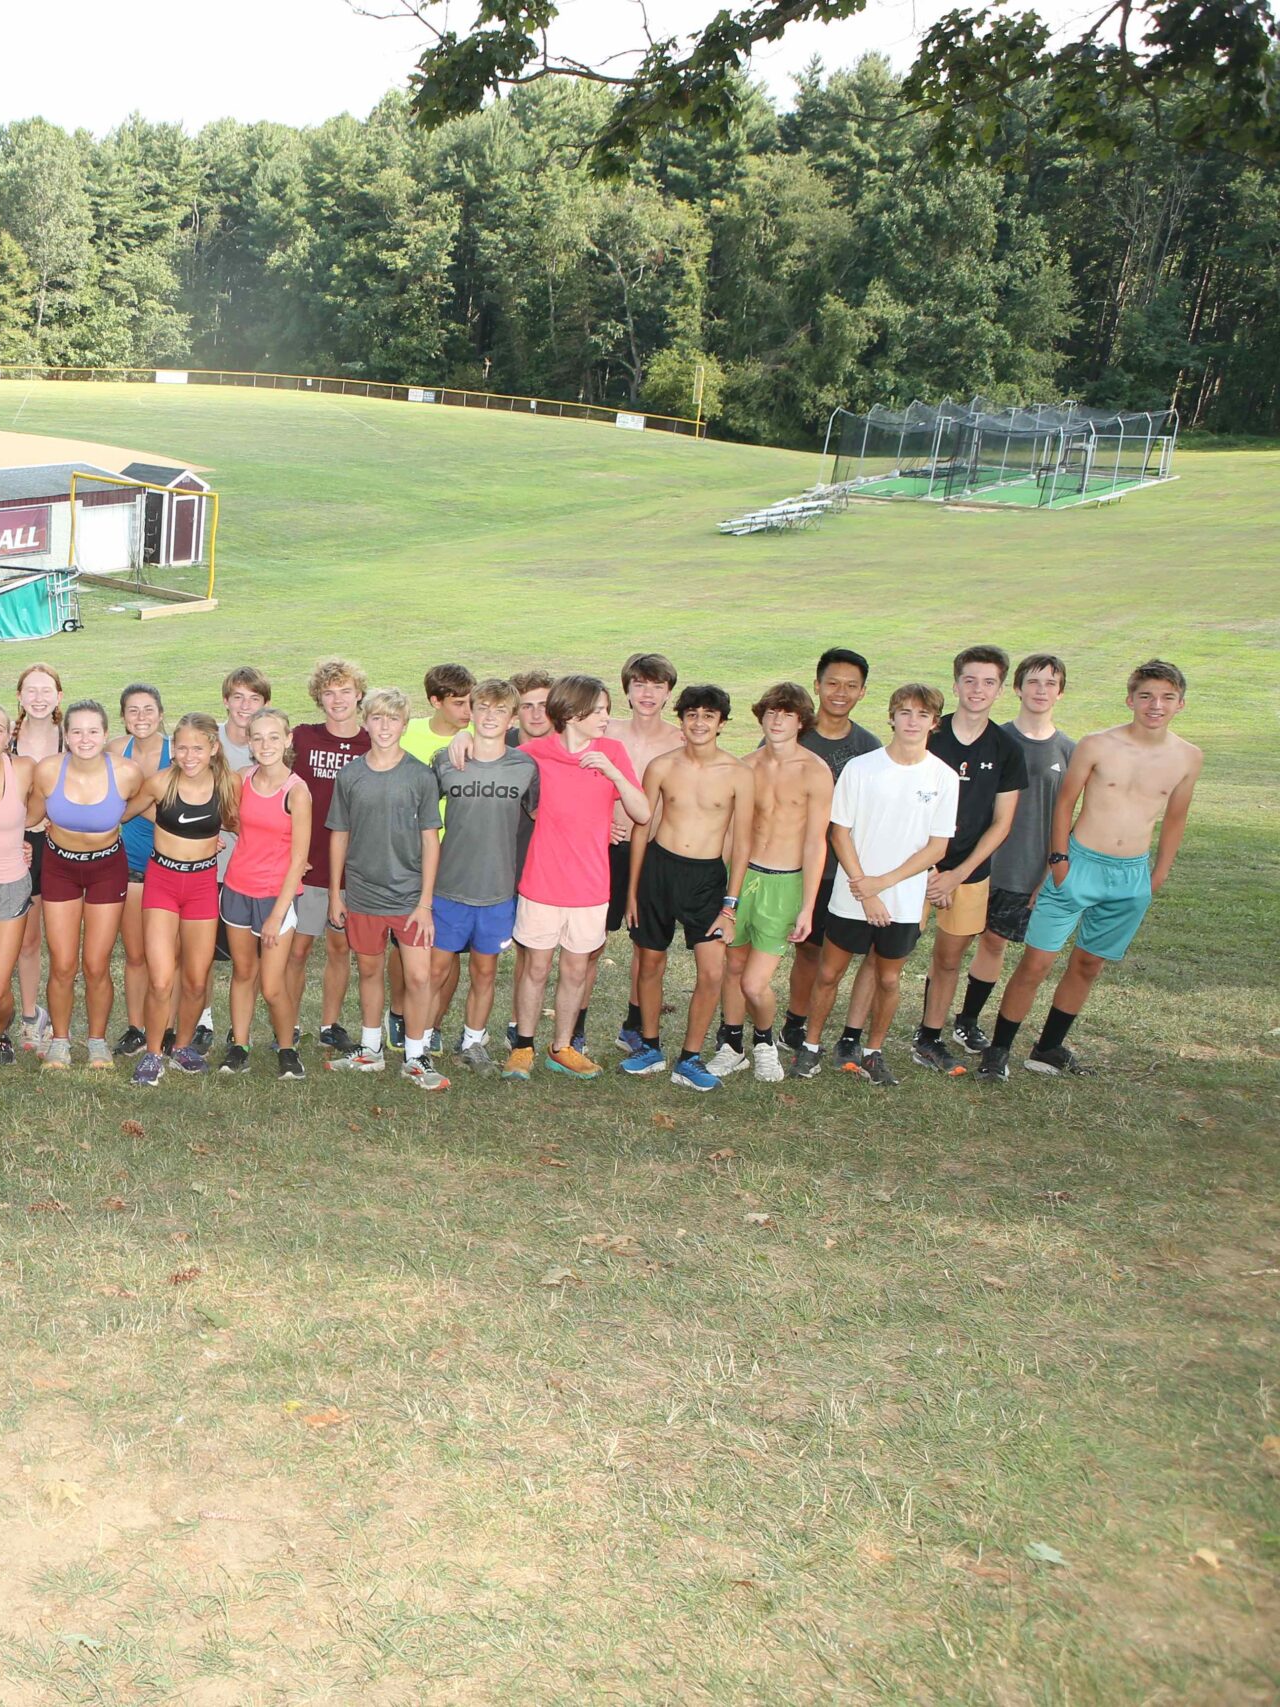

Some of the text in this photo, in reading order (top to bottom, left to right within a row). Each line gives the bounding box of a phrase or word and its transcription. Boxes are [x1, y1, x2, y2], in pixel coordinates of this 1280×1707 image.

[309, 749, 359, 770] HEREF
[313, 767, 338, 779] TRACK
[450, 781, 519, 799] adidas
[57, 843, 119, 861] NIKE PRO
[157, 856, 217, 872] NIKE PRO
